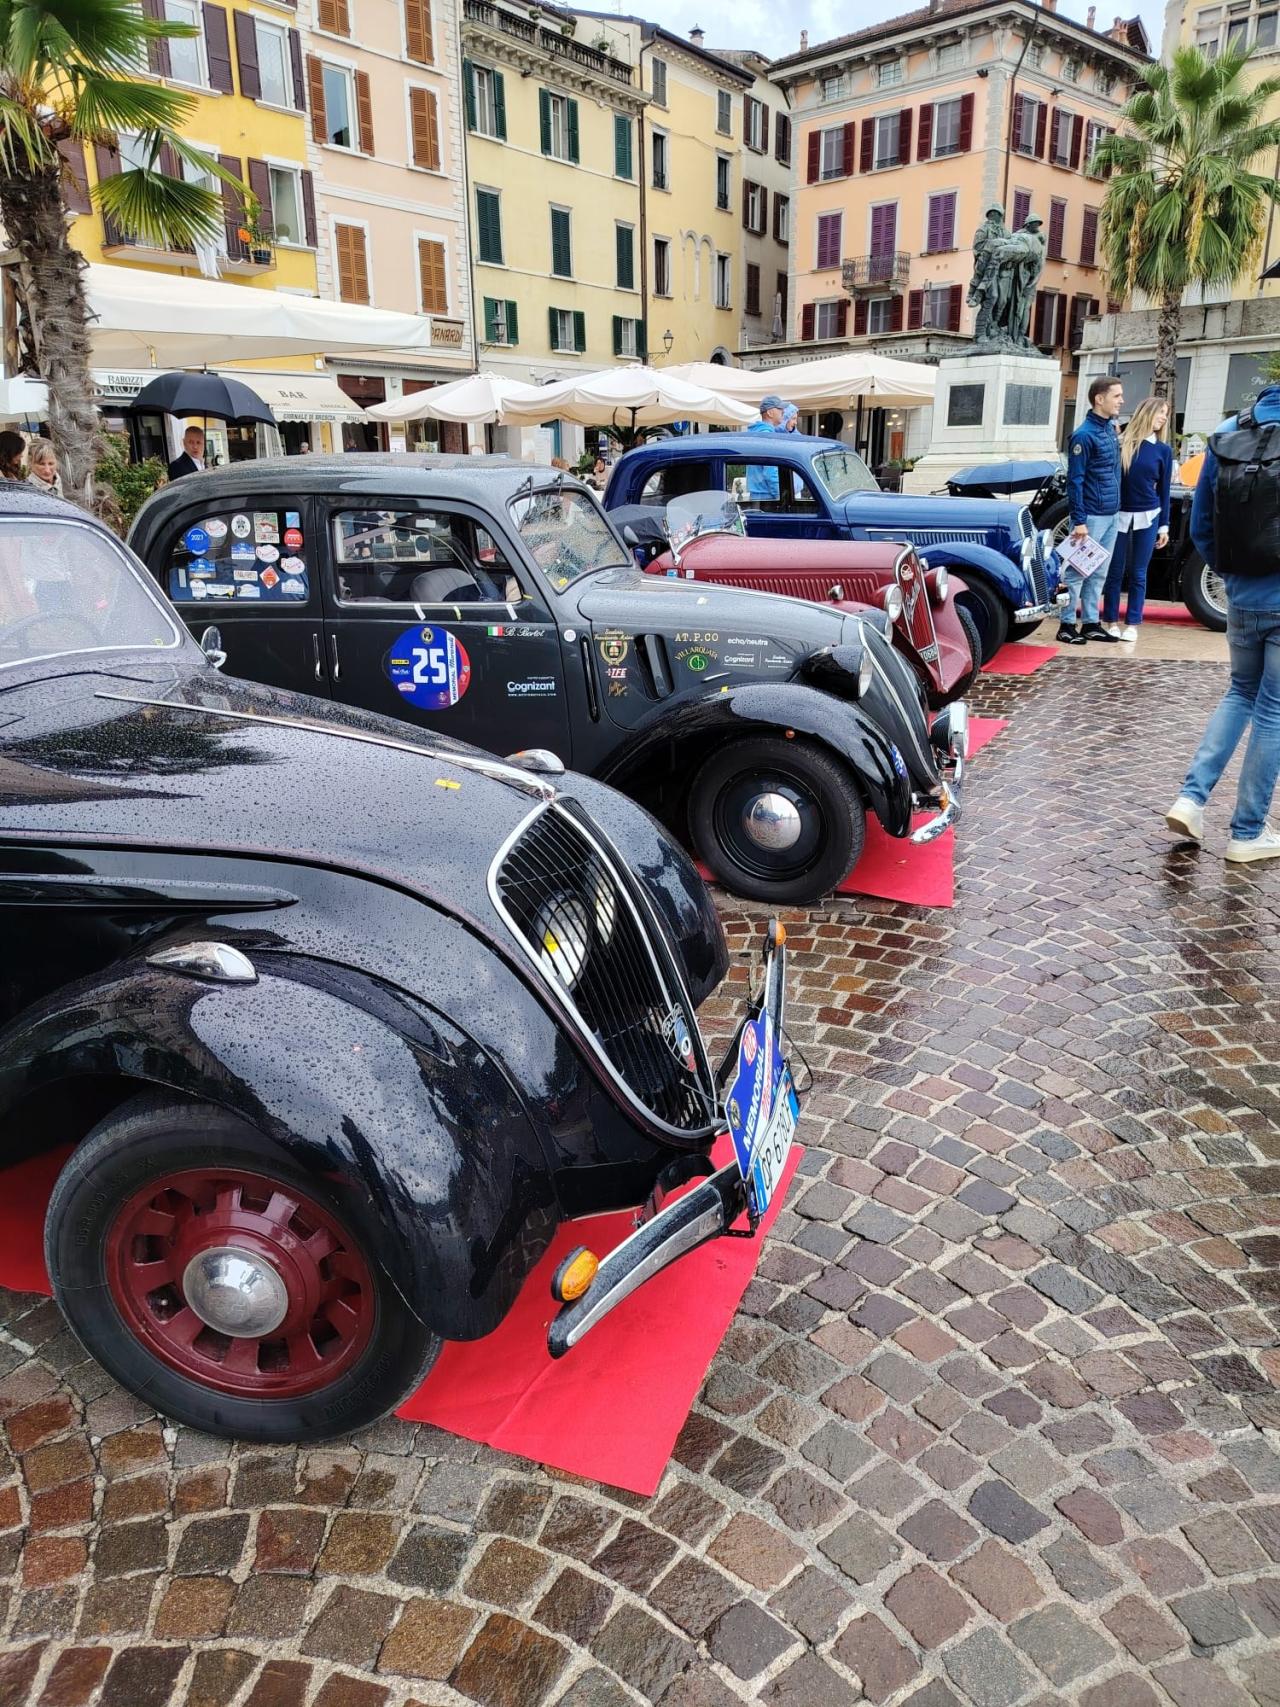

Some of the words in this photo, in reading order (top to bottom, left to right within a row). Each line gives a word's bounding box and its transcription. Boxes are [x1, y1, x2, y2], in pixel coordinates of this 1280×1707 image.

[107, 375, 144, 386] BAROZZI
[278, 390, 308, 399] BAR
[412, 648, 447, 684] 25
[507, 681, 556, 693] Cognizant
[743, 1048, 764, 1152] MEMORIAL
